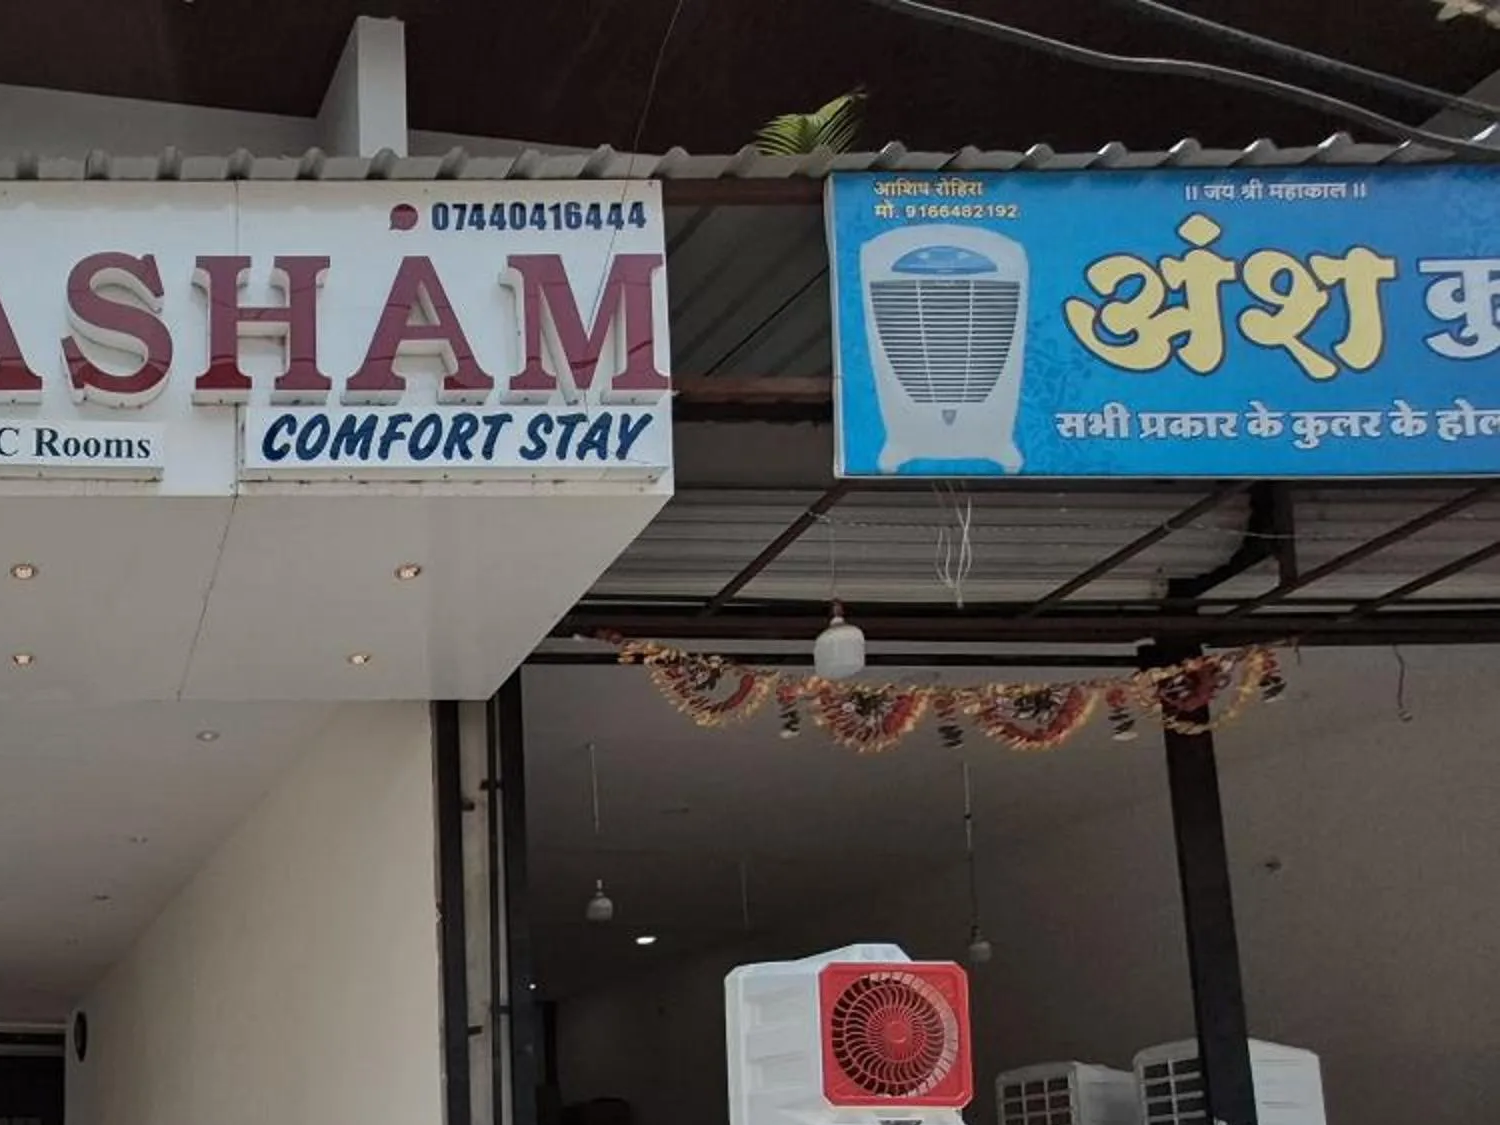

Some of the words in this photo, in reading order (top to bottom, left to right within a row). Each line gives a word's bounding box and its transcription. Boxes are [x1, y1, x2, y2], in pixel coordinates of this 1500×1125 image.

[1204, 184, 1234, 201] जय
[1240, 179, 1263, 201] श्री
[1268, 182, 1347, 201] महाकाल
[431, 201, 647, 231] 07440416444
[1062, 212, 1397, 382] अंश
[34, 427, 151, 460] Rooms
[261, 412, 513, 463] COMFORT
[519, 412, 654, 462] STAY
[1055, 401, 1131, 439] सभी
[1137, 411, 1238, 440] प्रकार
[1245, 400, 1285, 438] के
[1291, 411, 1382, 450] कुलर
[1387, 399, 1429, 438] के
